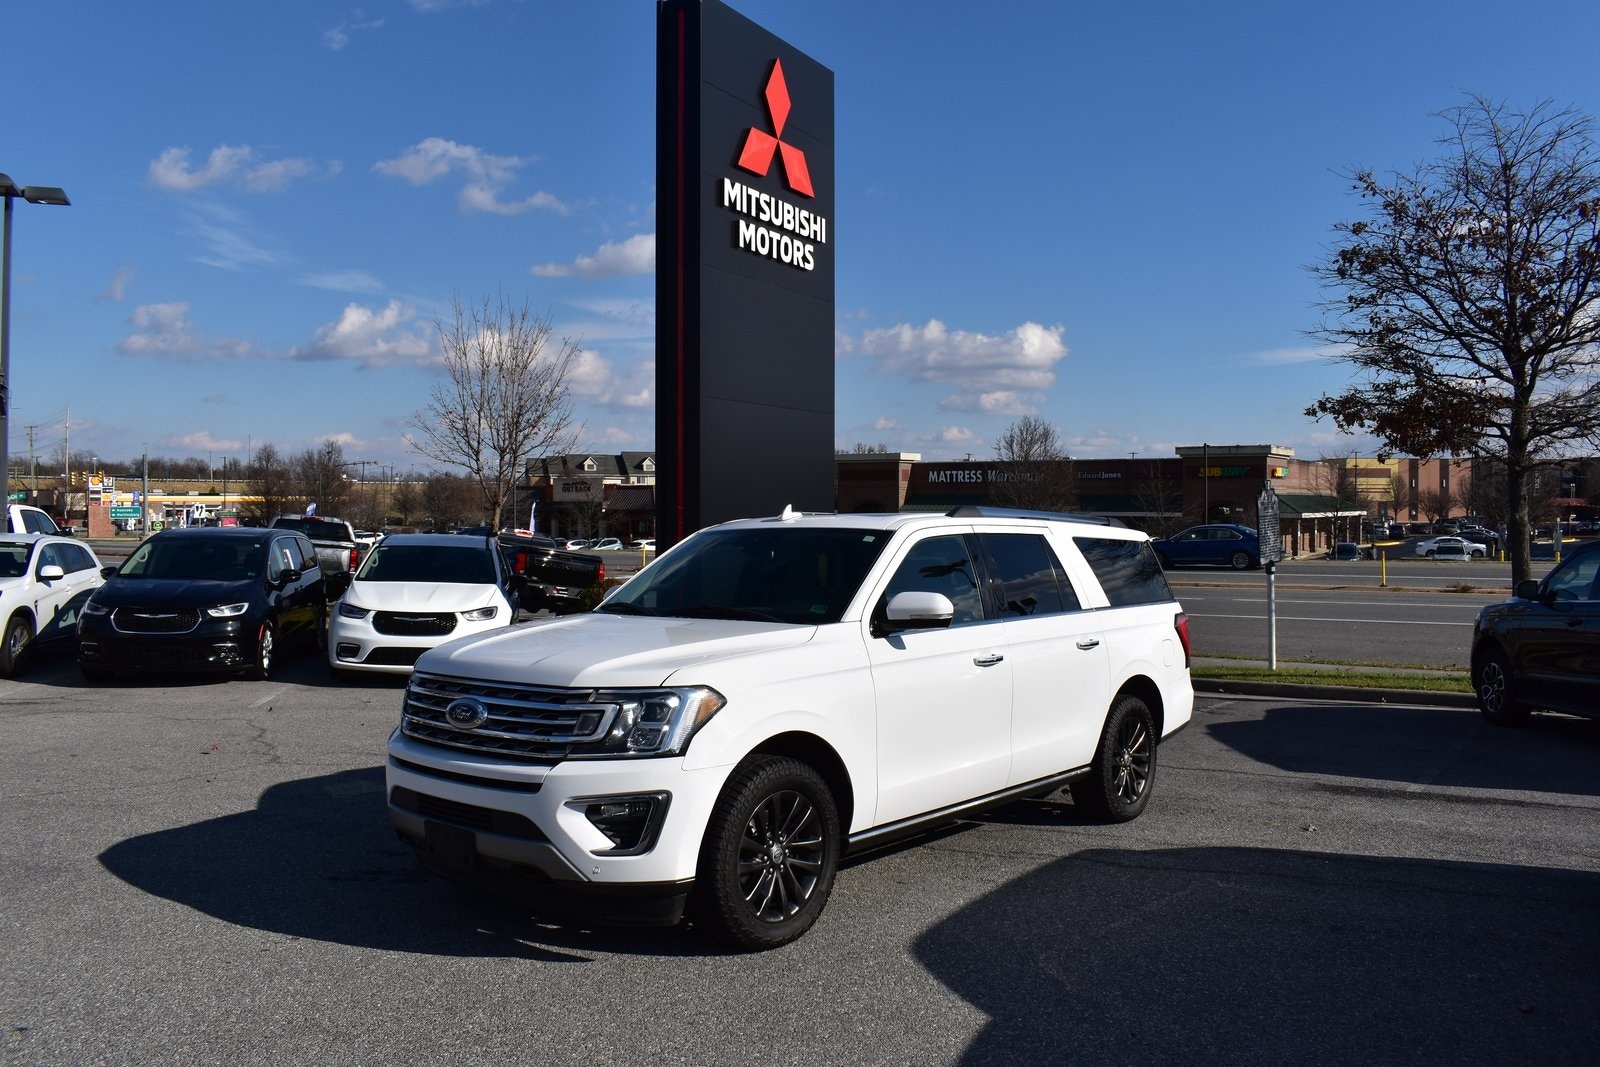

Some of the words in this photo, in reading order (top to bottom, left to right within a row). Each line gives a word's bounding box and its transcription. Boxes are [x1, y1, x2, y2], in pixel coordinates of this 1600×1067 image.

[723, 177, 826, 244] MITSUBISHI
[739, 219, 815, 271] MOTORS
[928, 470, 983, 483] MATTRESS
[1078, 471, 1101, 480] Edward
[1101, 471, 1122, 480] Jones
[1198, 466, 1250, 477] SUBWAY
[452, 706, 472, 720] Ford
